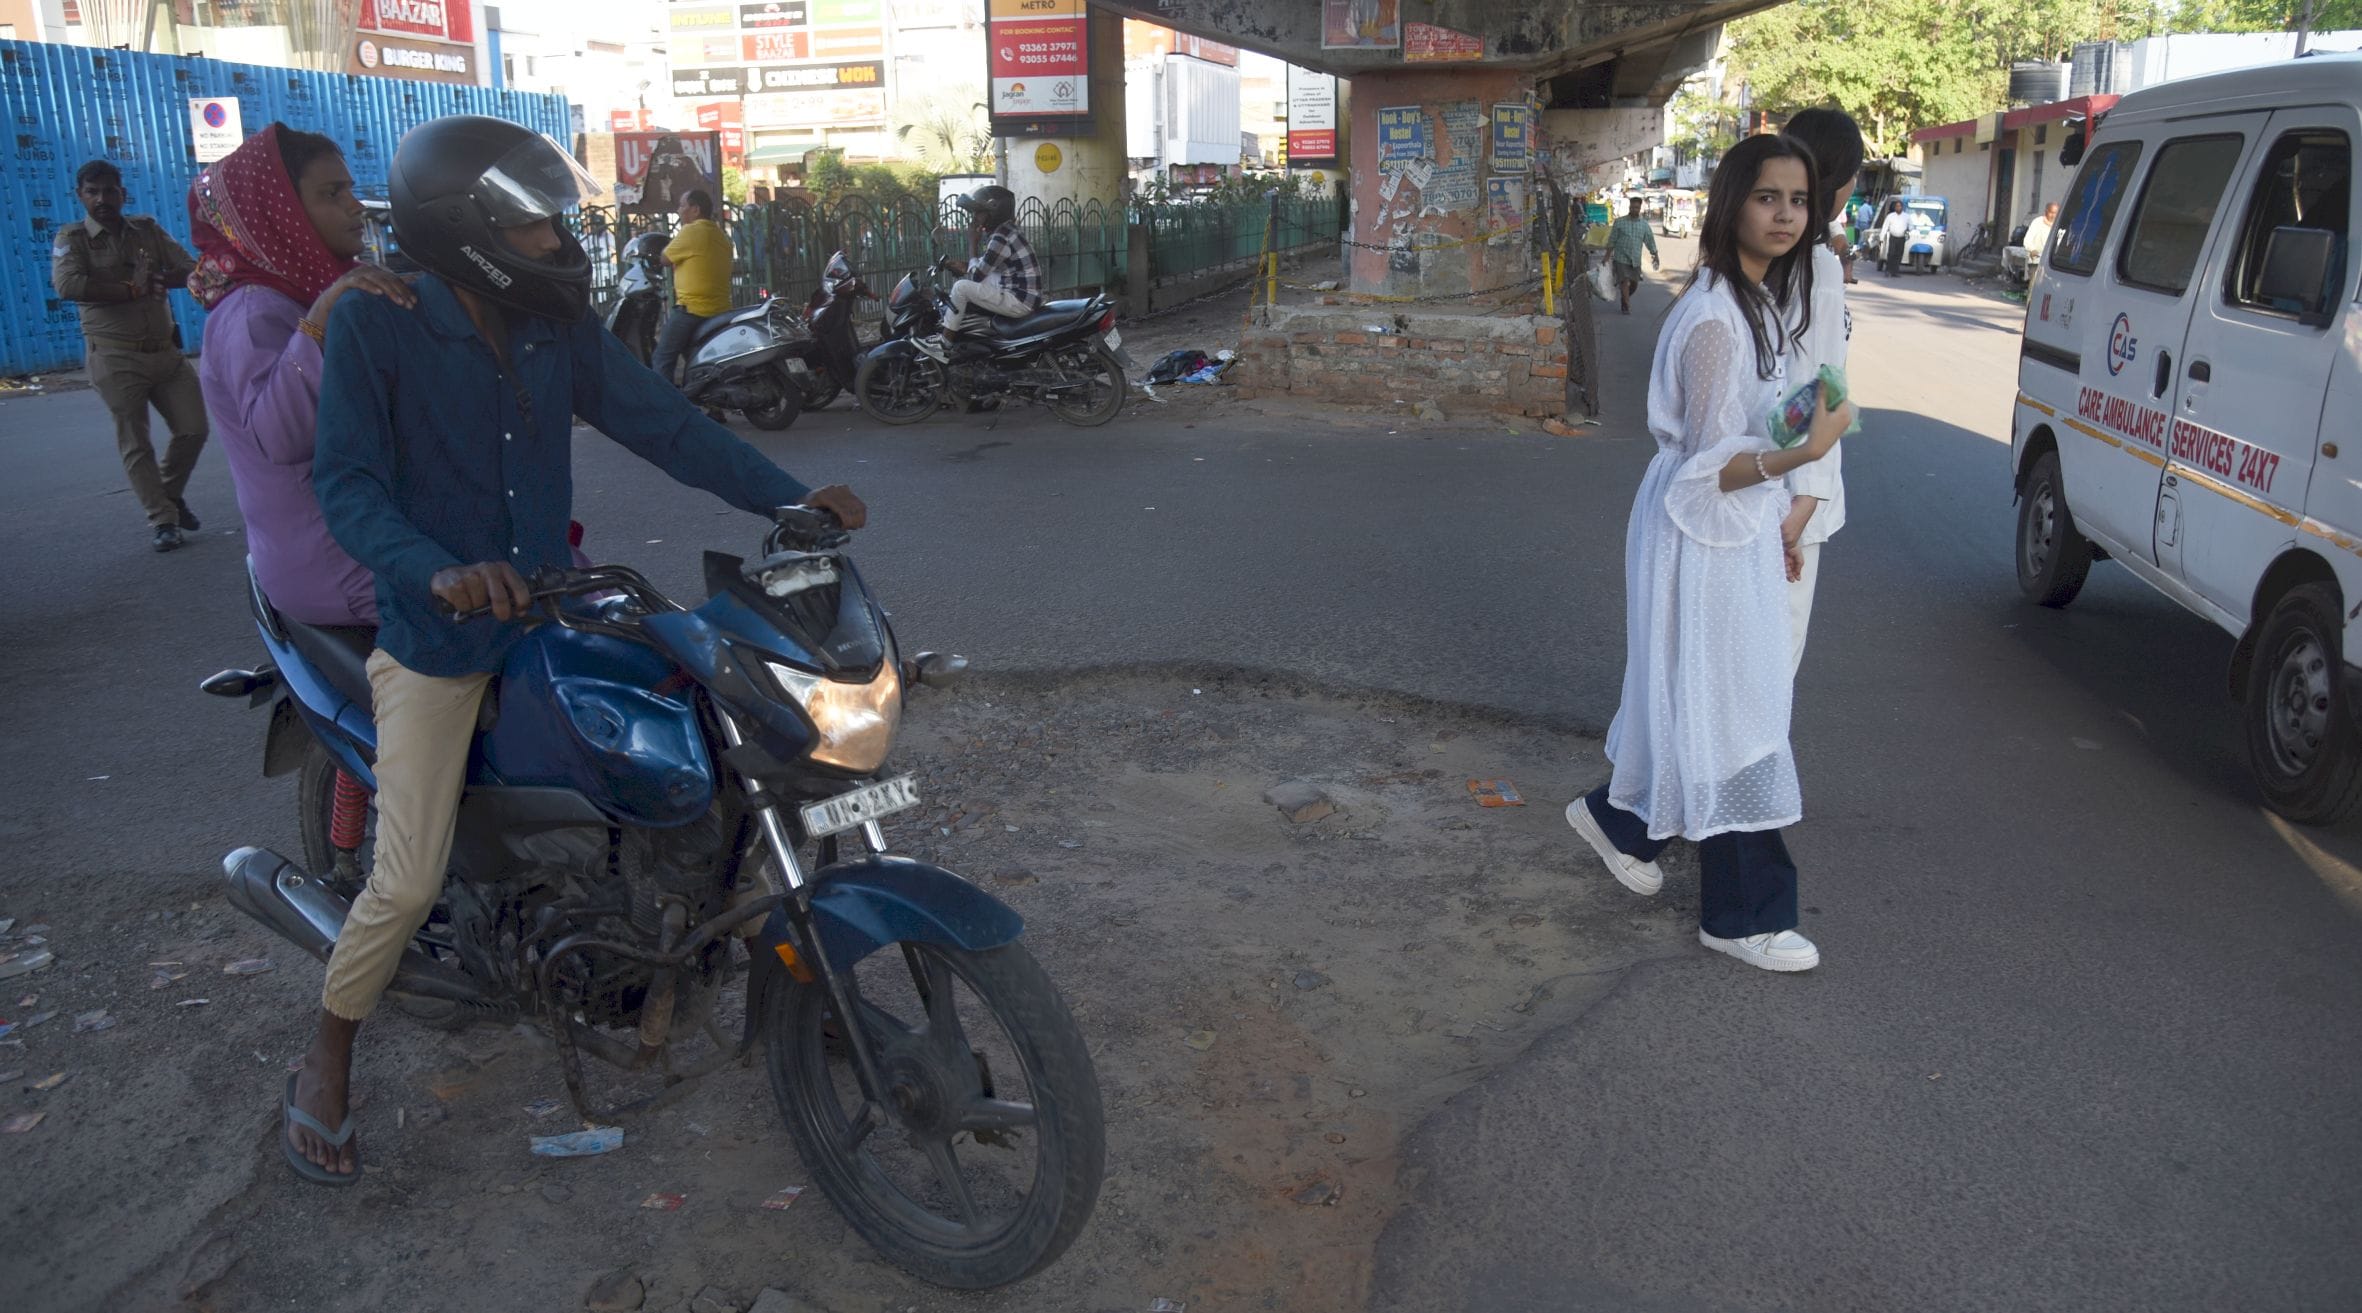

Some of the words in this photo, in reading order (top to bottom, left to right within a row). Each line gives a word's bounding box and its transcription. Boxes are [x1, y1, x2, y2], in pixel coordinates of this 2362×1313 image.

[381, 0, 441, 27] BAAZAR
[1020, 0, 1056, 10] METRO
[1015, 27, 1045, 35] BOOKING
[755, 33, 795, 49] STYLE
[1019, 43, 1048, 52] 93362
[382, 47, 434, 69] BURGER
[434, 53, 466, 73] KING
[1019, 55, 1048, 64] 93055
[838, 66, 876, 83] WOK
[460, 245, 513, 286] AIRZED
[2112, 333, 2138, 361] CAS
[2078, 386, 2103, 423] CARE
[2102, 396, 2166, 448] AMBULANCE
[2171, 420, 2235, 477] SERVICES
[2237, 444, 2280, 494] 24X7
